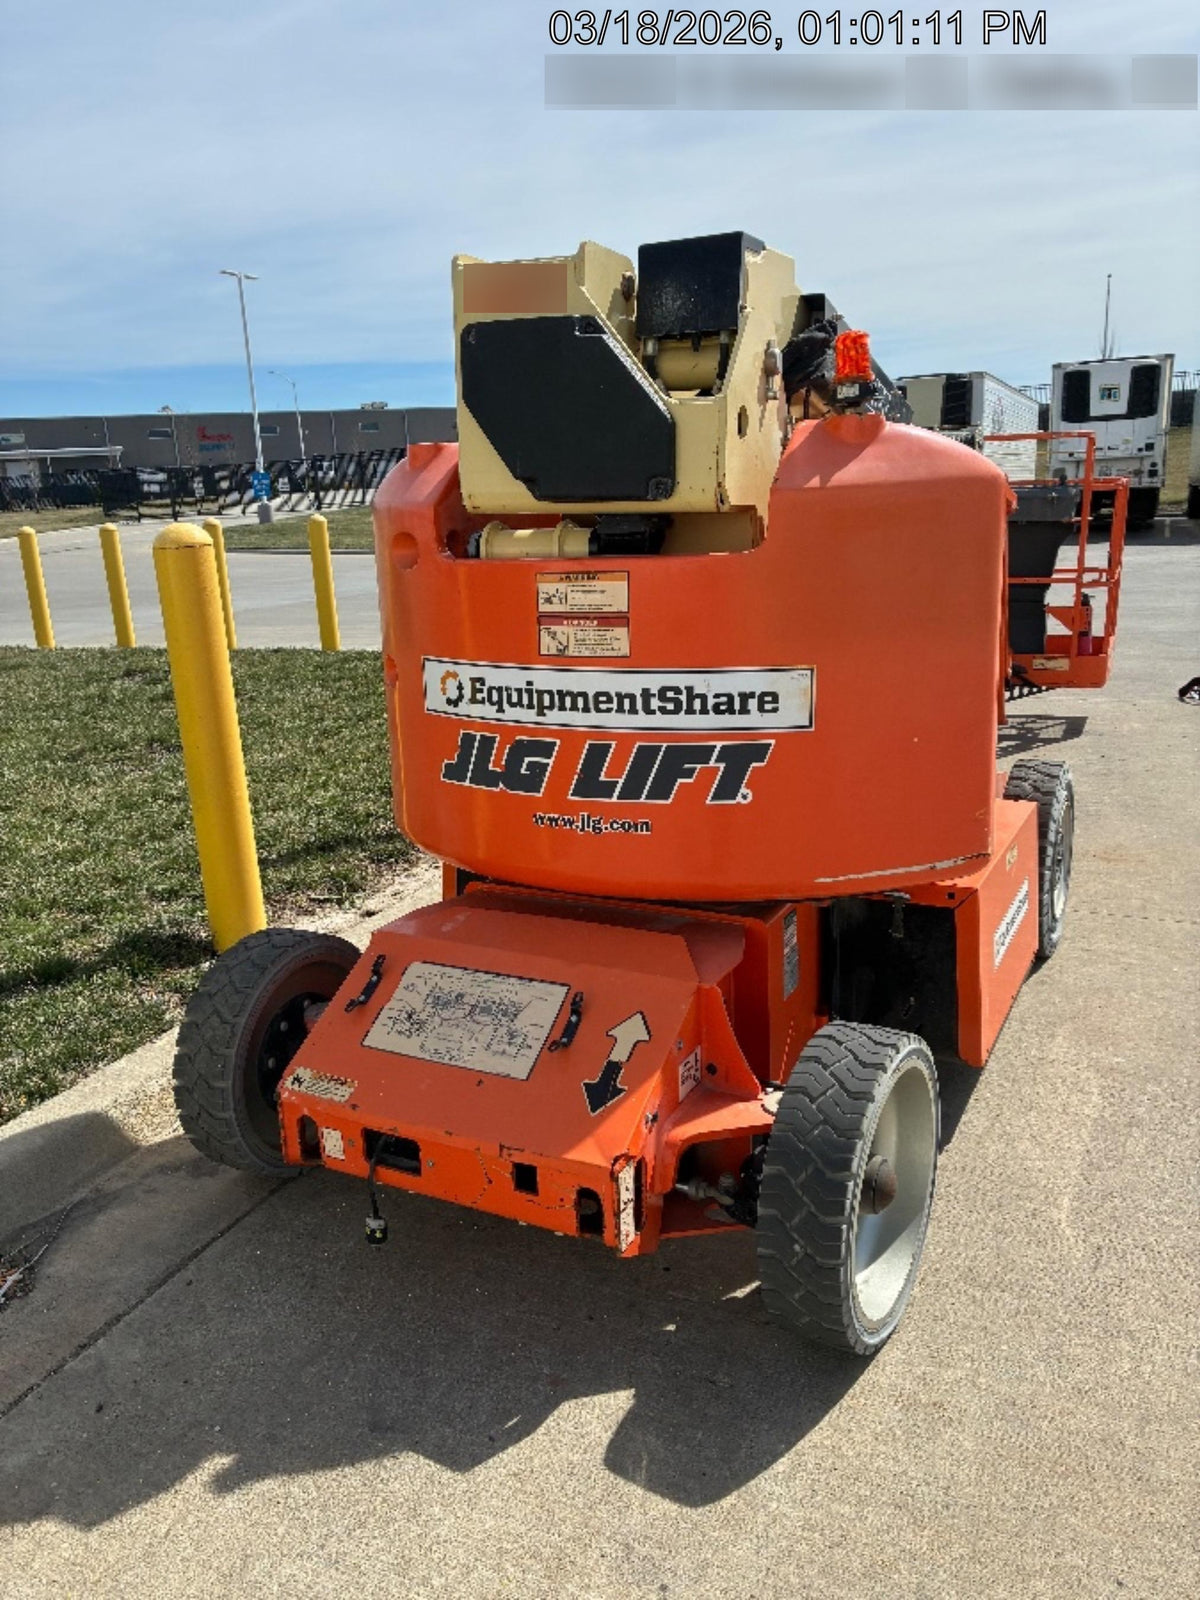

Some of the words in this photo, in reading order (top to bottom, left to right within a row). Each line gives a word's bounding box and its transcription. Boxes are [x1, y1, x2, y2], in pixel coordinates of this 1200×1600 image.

[469, 677, 779, 716] EquipmentShare
[441, 731, 560, 796] JLG
[568, 740, 775, 804] LIFT
[533, 811, 652, 834] www.jlg.com
